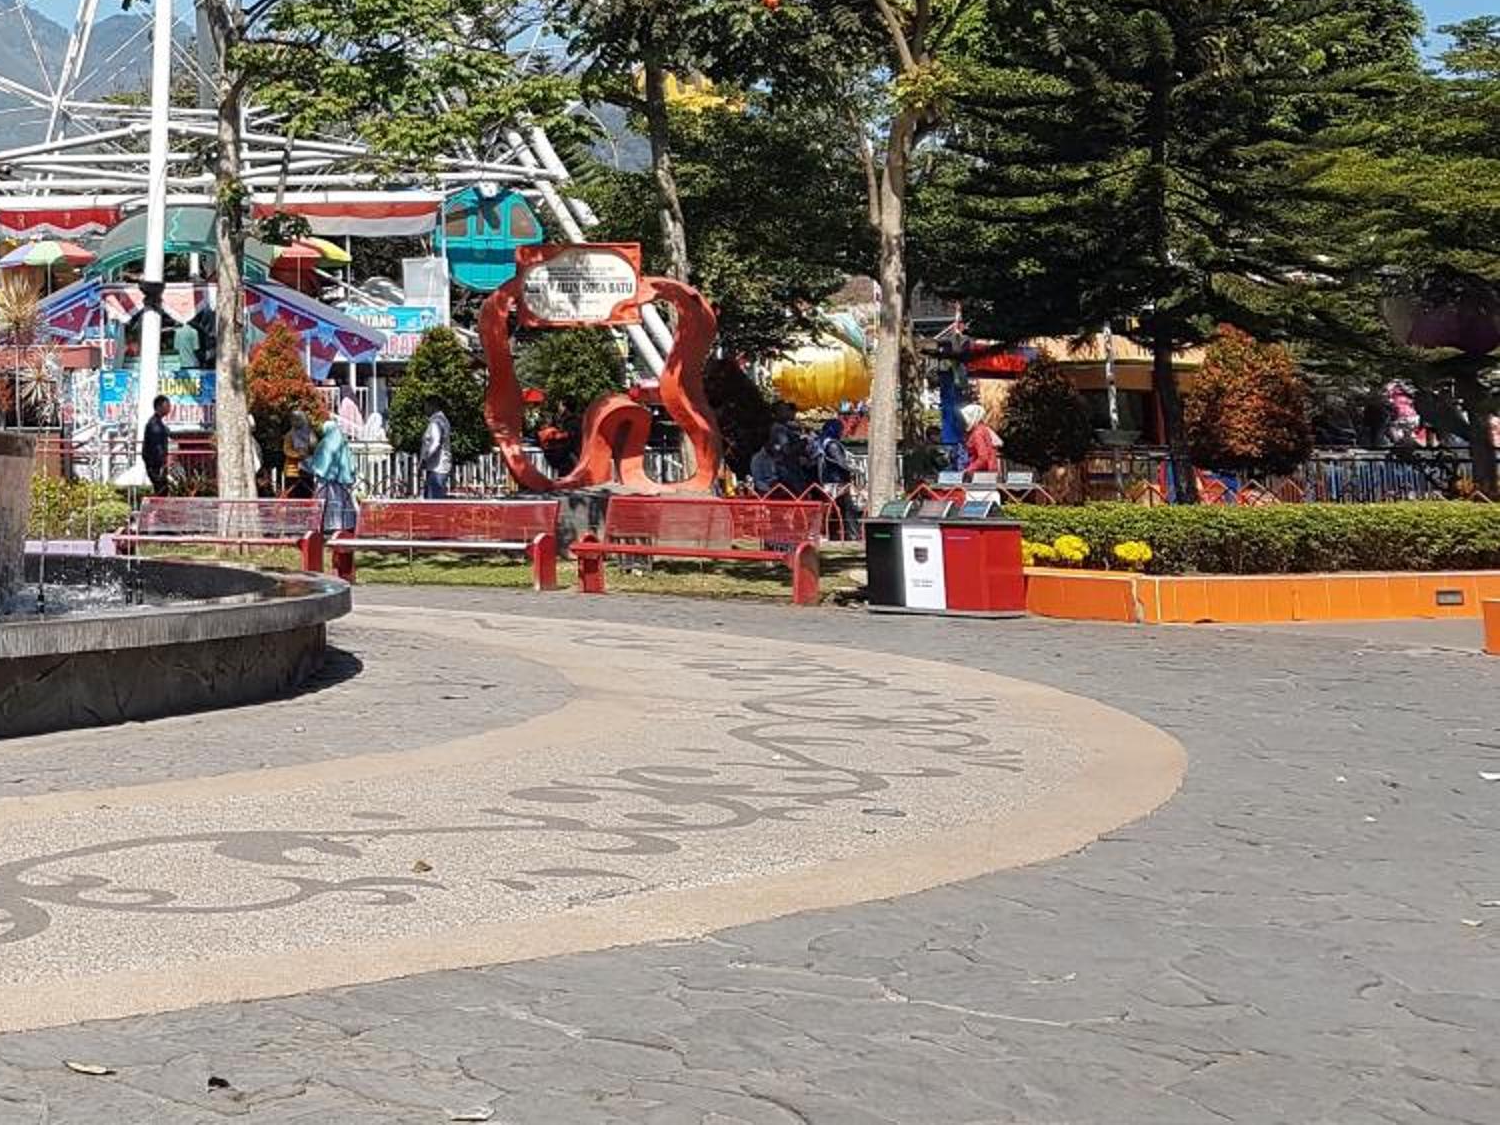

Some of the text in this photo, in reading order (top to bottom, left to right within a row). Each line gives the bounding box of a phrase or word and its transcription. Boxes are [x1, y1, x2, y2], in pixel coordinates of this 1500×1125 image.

[581, 283, 606, 294] KOTA
[609, 283, 633, 294] BATU
[156, 378, 201, 396] ELCOME
